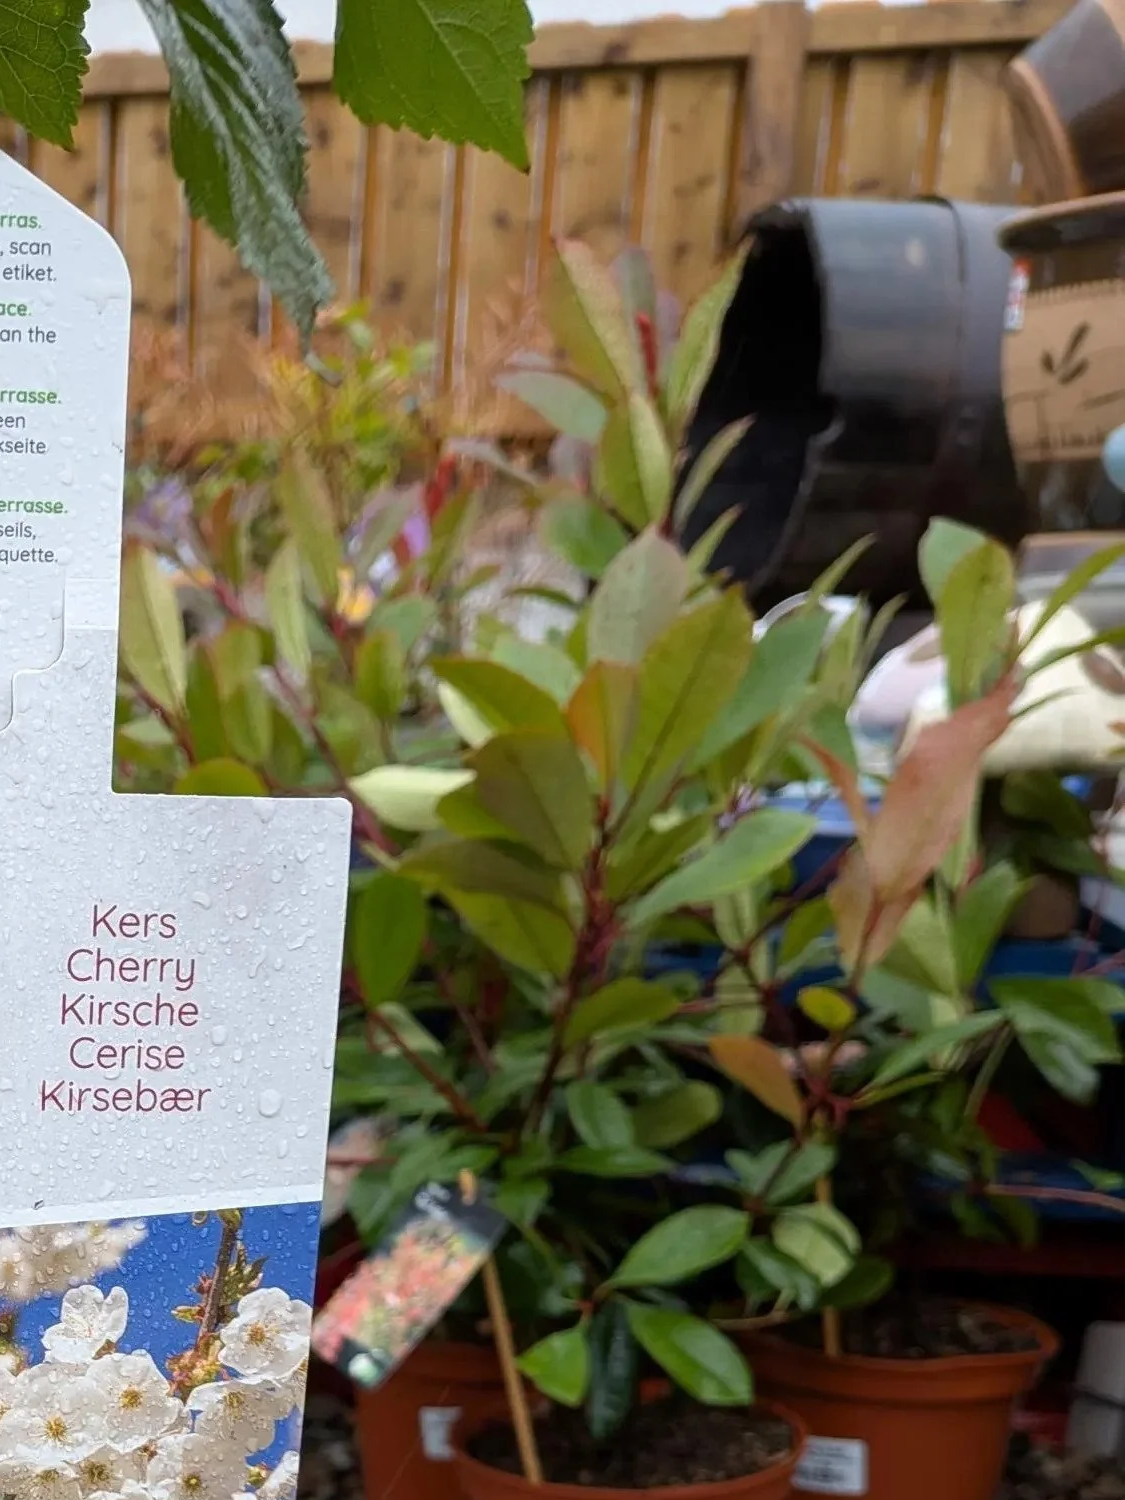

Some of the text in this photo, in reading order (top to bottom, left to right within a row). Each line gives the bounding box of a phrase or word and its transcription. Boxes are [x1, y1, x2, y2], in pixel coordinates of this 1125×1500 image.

[9, 242, 51, 256] scan
[3, 264, 56, 281] etiket.
[28, 326, 56, 343] the
[92, 904, 176, 938] Kers
[67, 948, 195, 991] Cherry
[61, 993, 198, 1026] Kirsche
[70, 1037, 184, 1070] Cerise
[41, 1079, 211, 1112] Kirsebær
